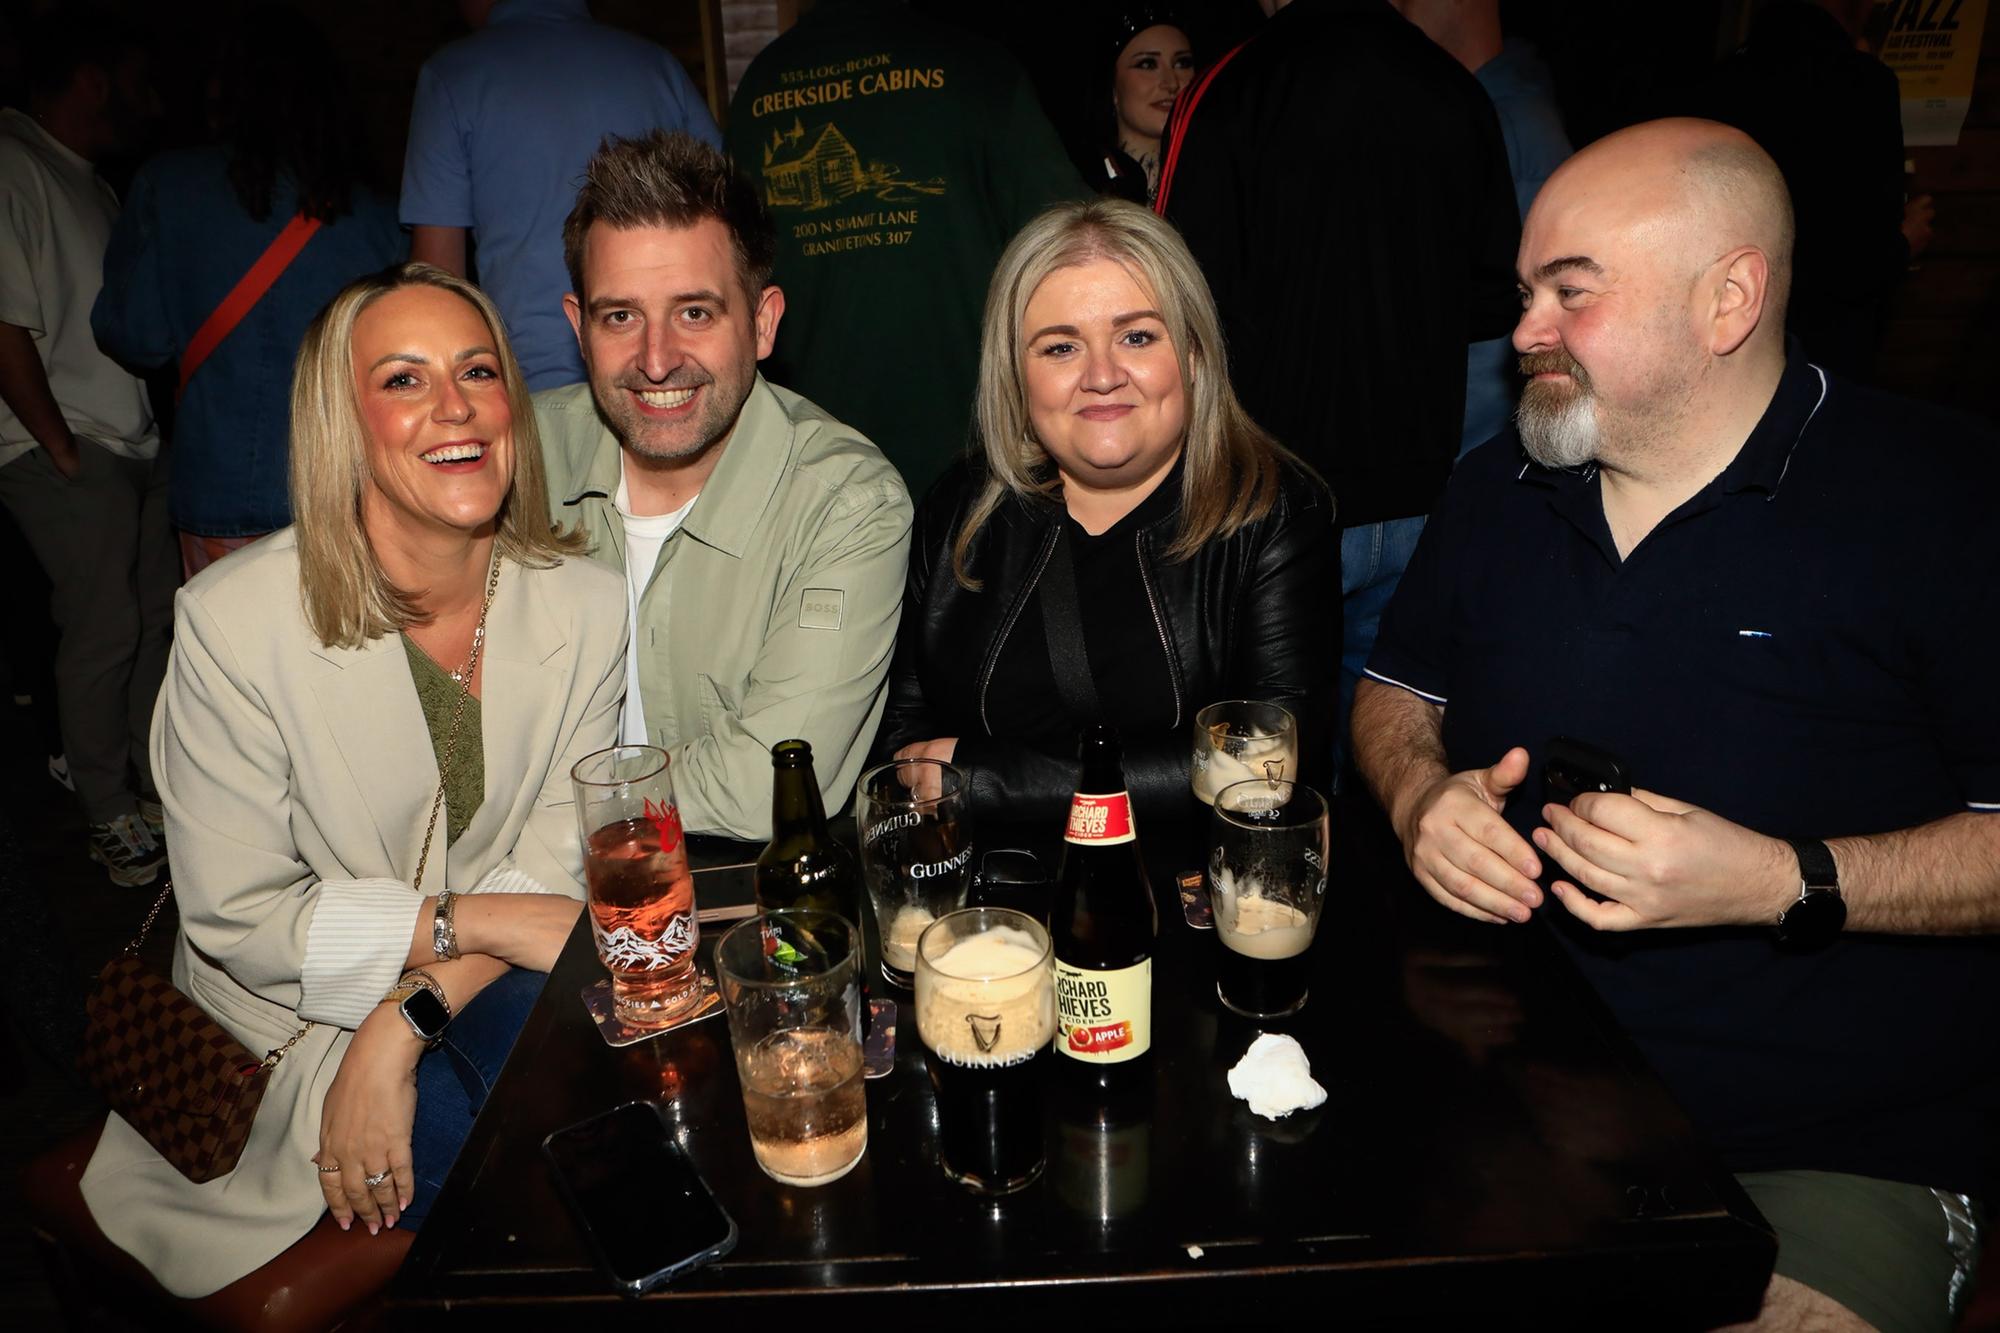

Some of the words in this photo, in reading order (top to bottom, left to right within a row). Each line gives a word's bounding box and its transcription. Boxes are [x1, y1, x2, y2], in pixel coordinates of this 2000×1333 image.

[1903, 33, 1953, 48] FESTIVAL
[752, 79, 852, 118] CREEKSIDE
[859, 68, 945, 95] CABINS
[793, 222, 818, 238] 200
[820, 220, 832, 234] N
[879, 210, 918, 226] LANE
[886, 230, 913, 245] 307
[805, 603, 839, 614] BOSS
[1057, 976, 1107, 998] RCHARD
[664, 991, 689, 1005] COLD
[1058, 994, 1112, 1017] HIEVES
[1066, 1016, 1094, 1025] CIDER
[1095, 1027, 1125, 1042] APPLE
[936, 1044, 1036, 1070] GUINNESS
